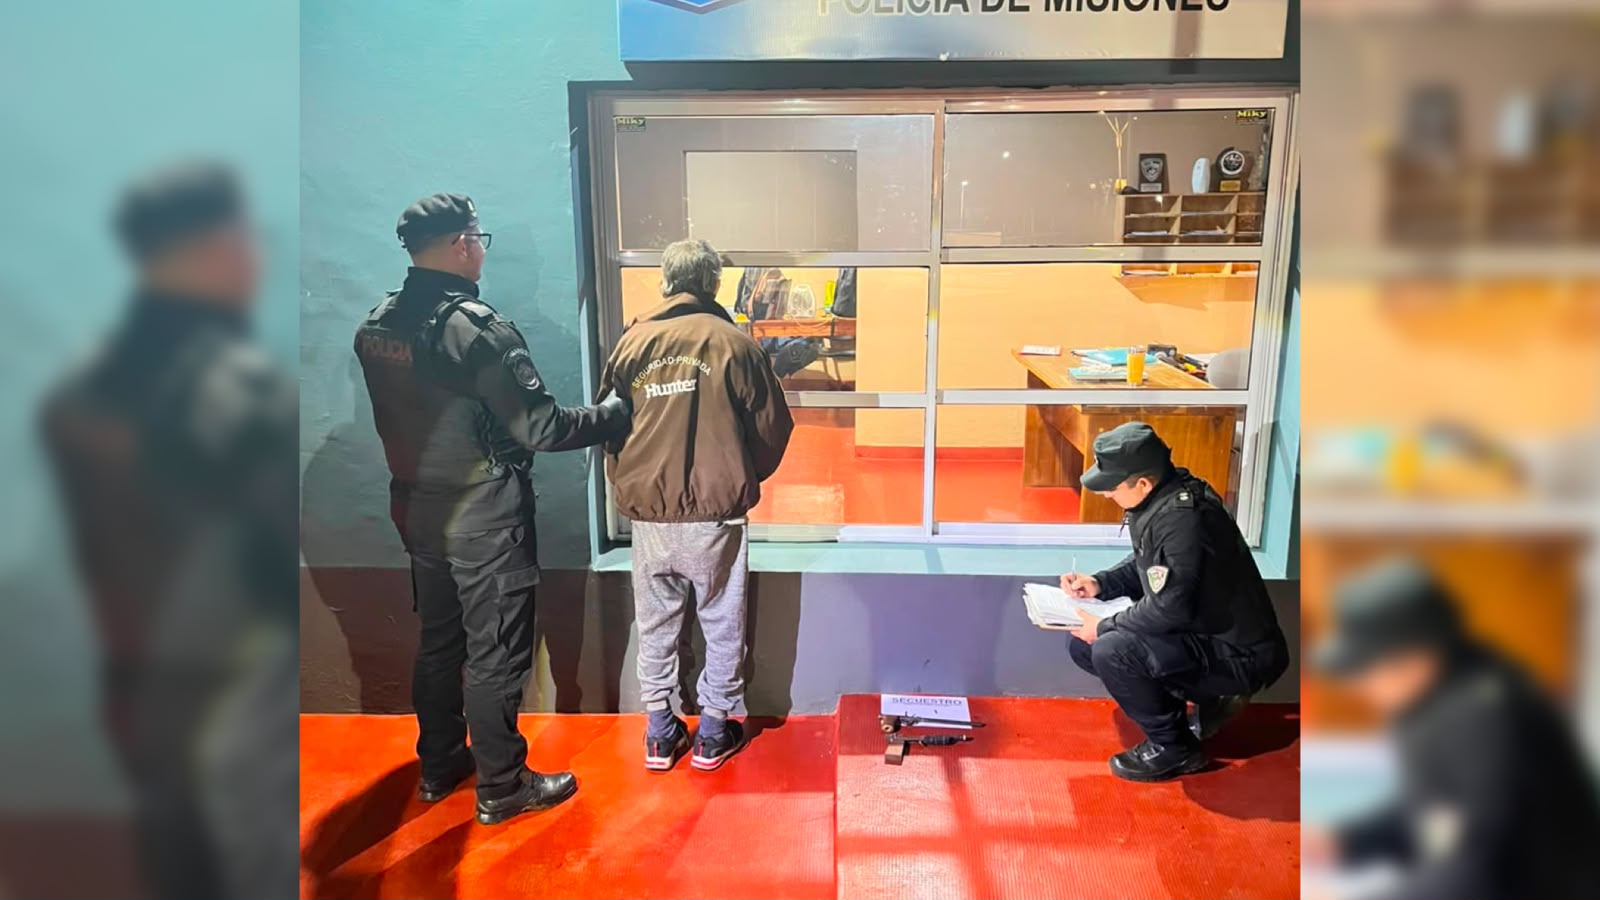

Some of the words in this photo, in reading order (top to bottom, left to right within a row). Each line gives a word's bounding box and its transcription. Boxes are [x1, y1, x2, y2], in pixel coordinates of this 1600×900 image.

[1236, 110, 1267, 118] Miky
[616, 118, 645, 126] Miky
[644, 379, 697, 398] Hunter
[892, 697, 962, 706] SECUESTRO
